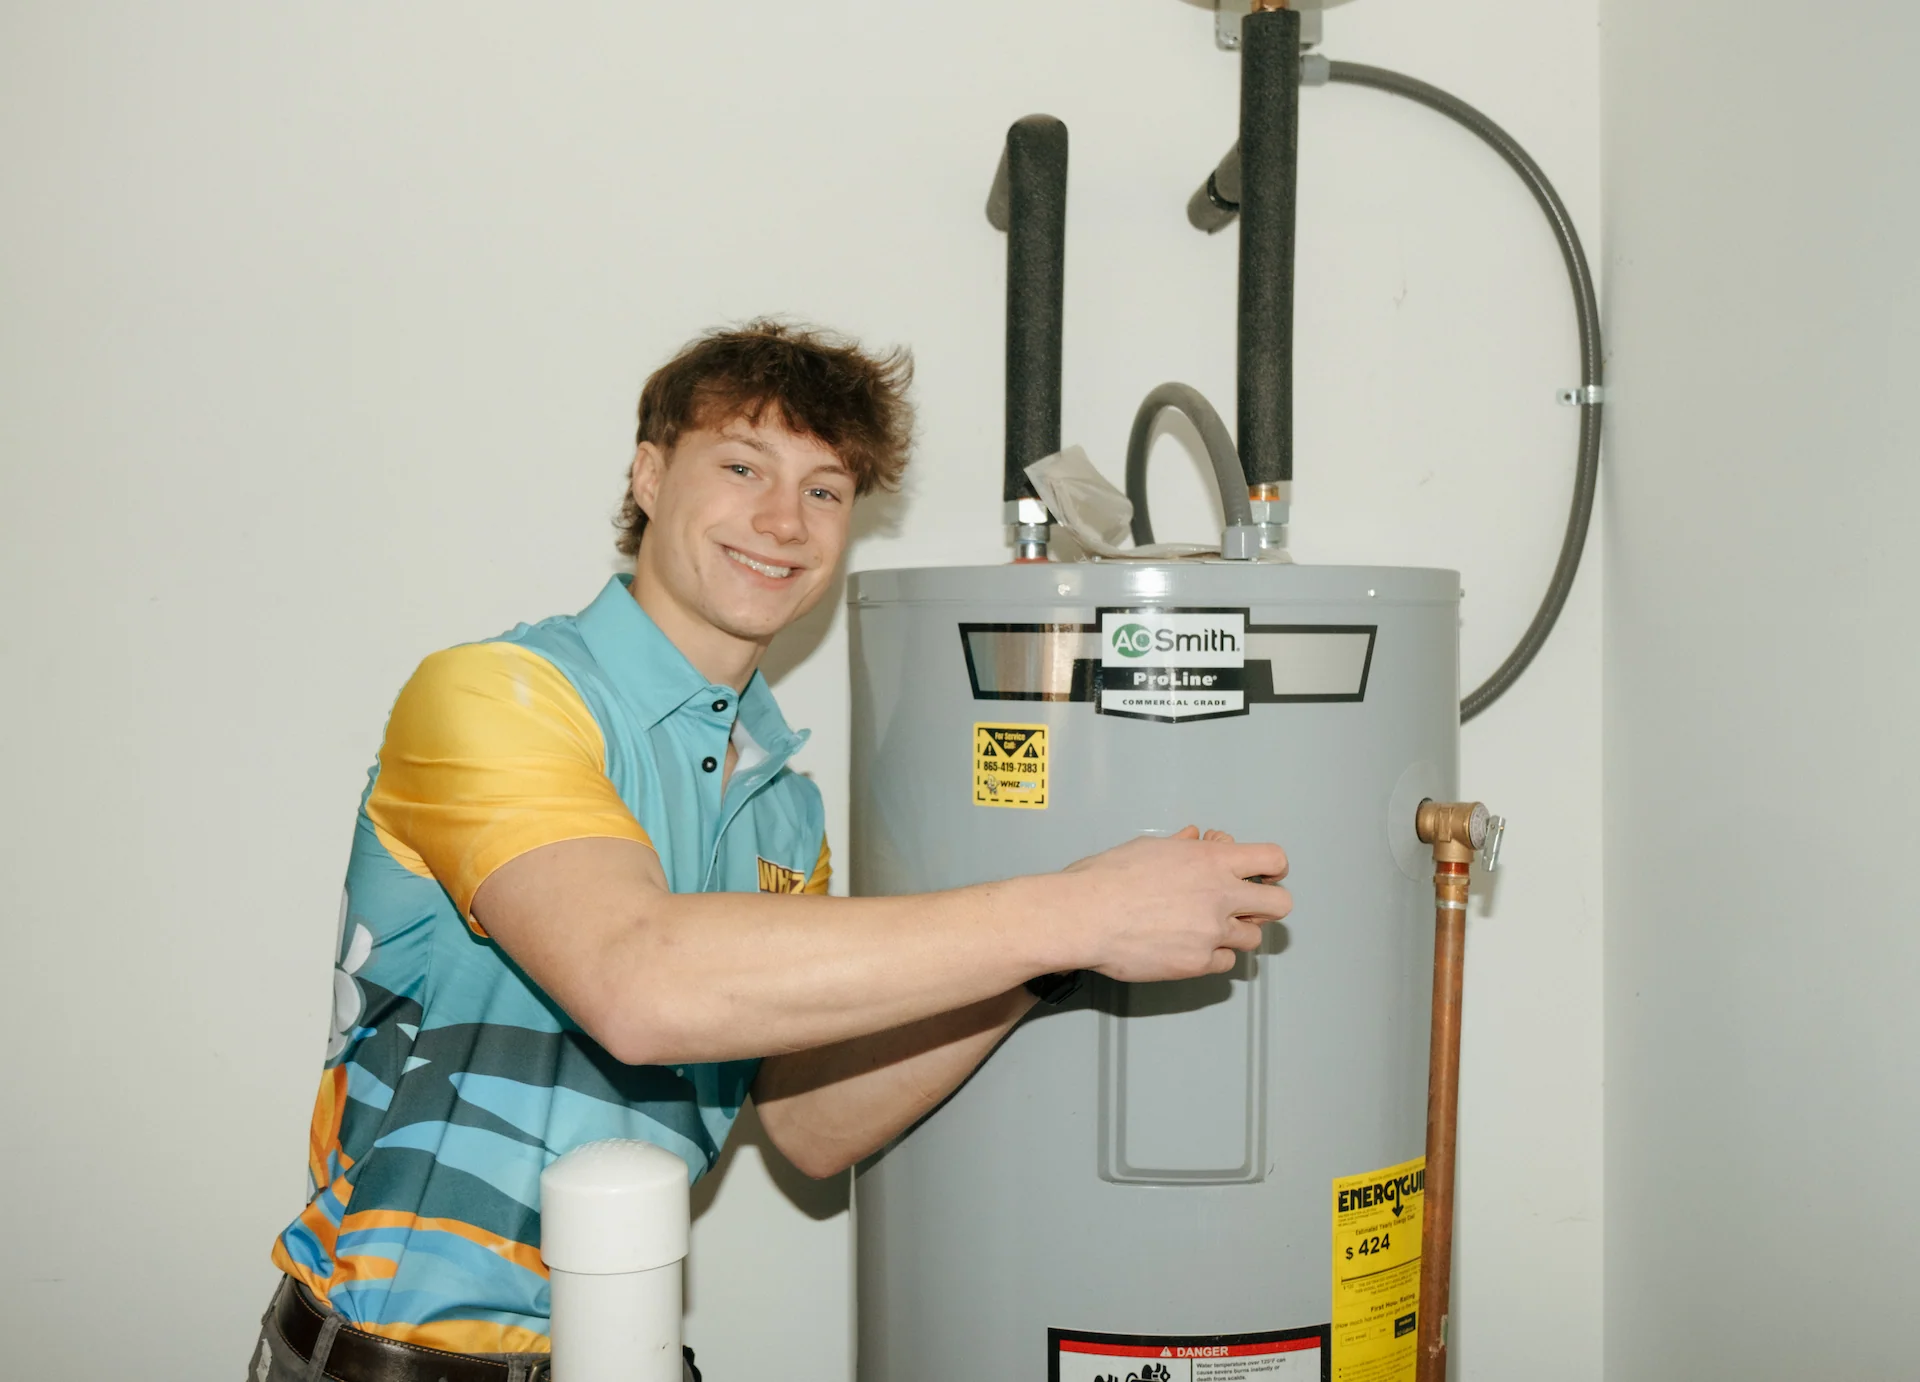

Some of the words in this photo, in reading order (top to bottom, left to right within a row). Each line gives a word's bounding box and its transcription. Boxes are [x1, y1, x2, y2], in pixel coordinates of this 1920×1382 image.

[1133, 672, 1214, 686] ProLine
[1004, 732, 1026, 741] Service
[984, 761, 1037, 773] 865-419-7383
[1359, 1233, 1390, 1256] 424
[1177, 1346, 1229, 1357] DANGER
[1213, 1361, 1247, 1369] temperature
